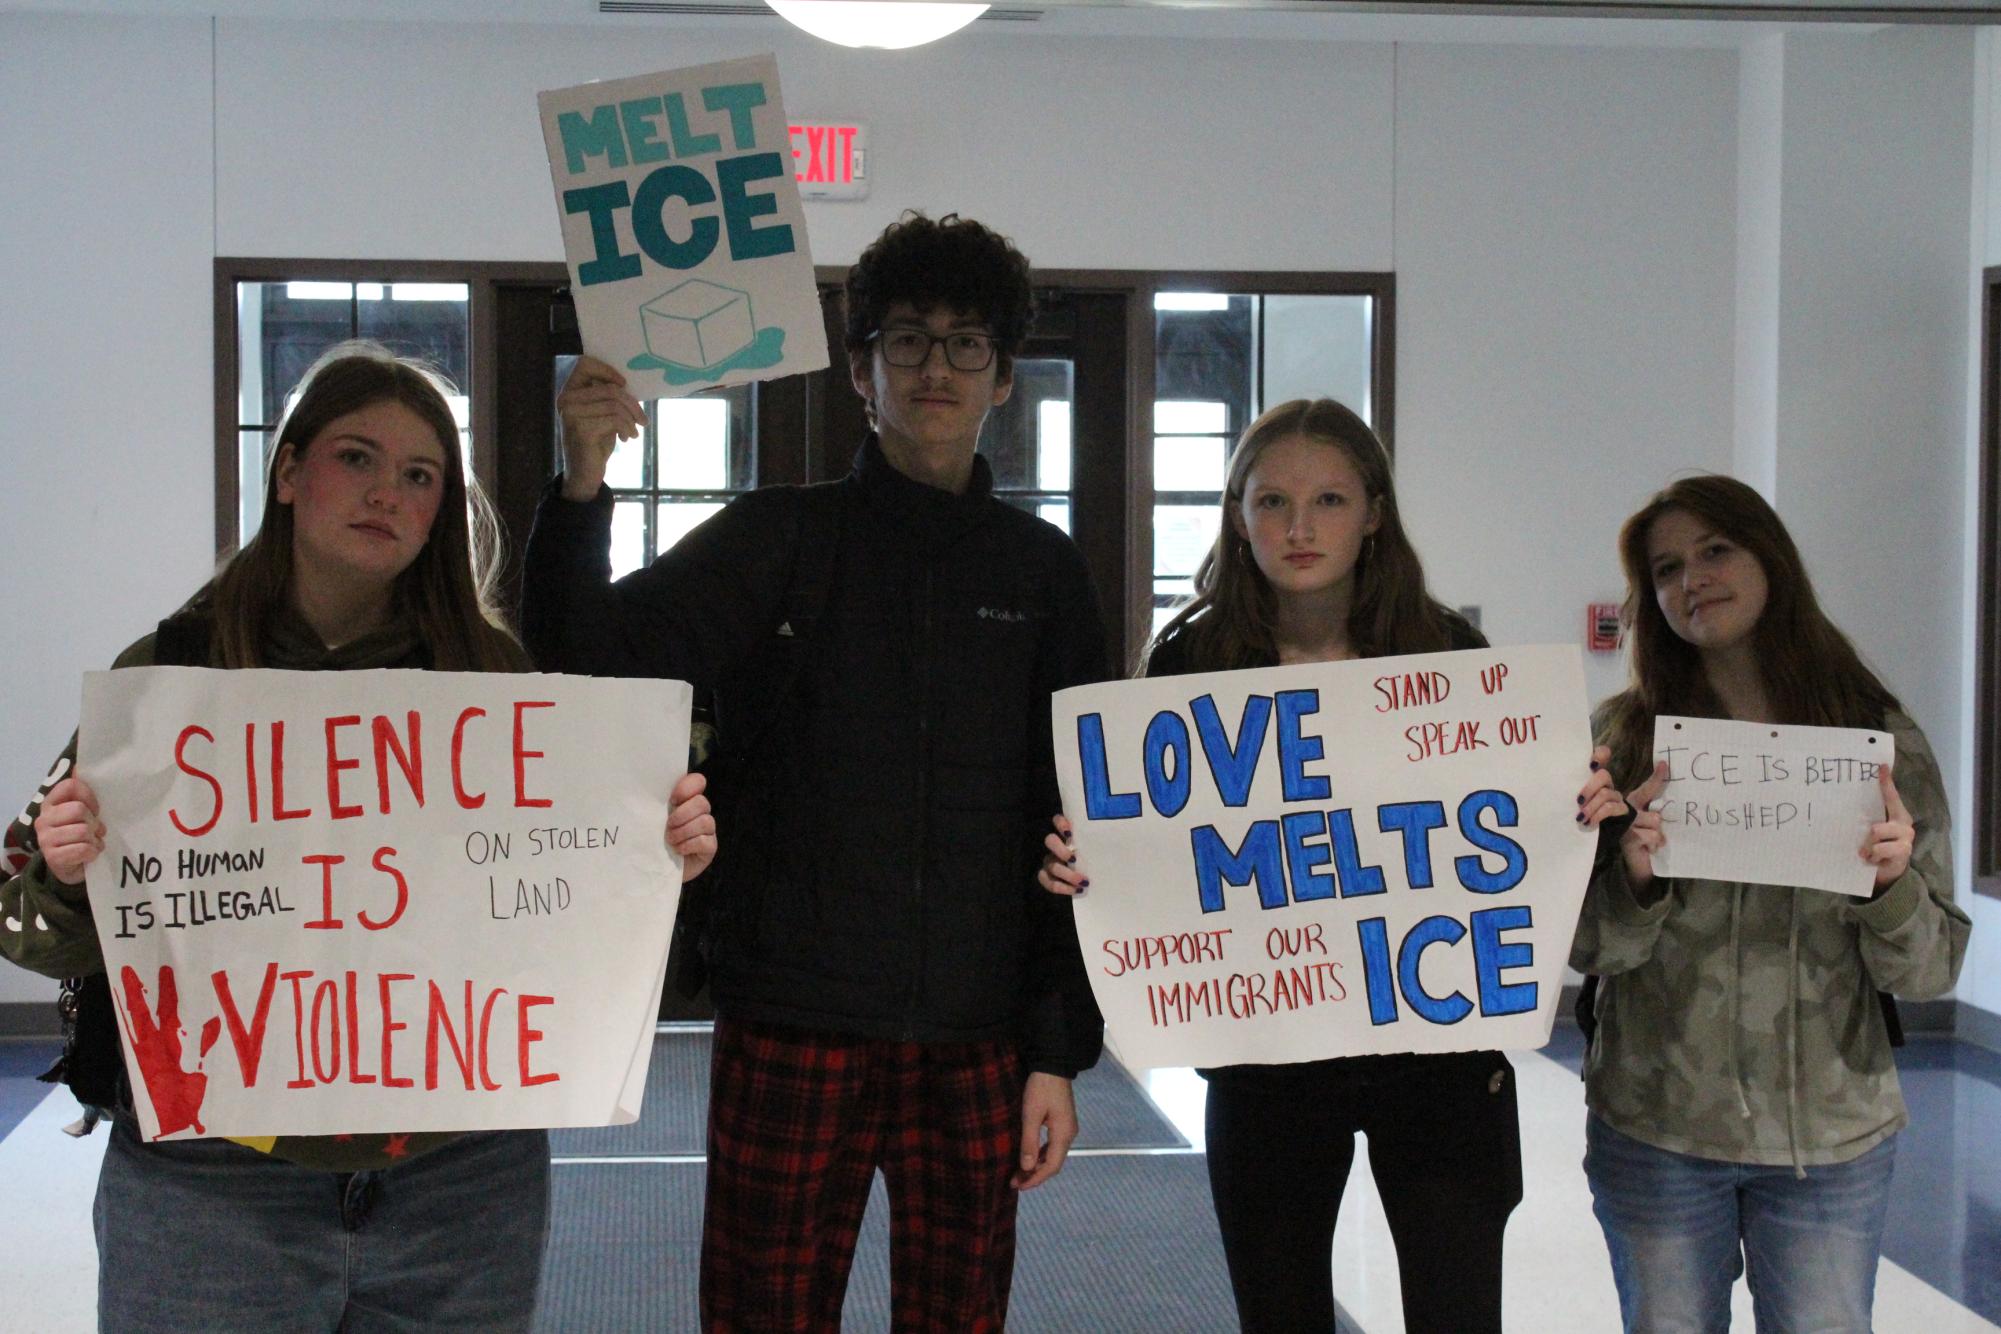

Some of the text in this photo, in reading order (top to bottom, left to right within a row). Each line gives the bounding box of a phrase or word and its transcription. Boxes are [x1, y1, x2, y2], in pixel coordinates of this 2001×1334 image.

[557, 82, 767, 175] MELT
[563, 152, 796, 287] ICE
[1374, 663, 1509, 713] STAND UP
[1076, 688, 1332, 820] LOVE
[1404, 714, 1542, 762] SPEAK OUT
[1658, 746, 1881, 786] ICE IS BETTER
[168, 701, 556, 837] SILENCE
[1659, 800, 1813, 830] CRUSHED!
[120, 854, 163, 888] NO
[466, 825, 620, 865] ON STOLEN
[1190, 789, 1529, 914] MELTS
[115, 885, 295, 938] IS ILLEGAL
[302, 846, 409, 930] IS
[489, 876, 572, 920] LAND
[1103, 923, 1328, 977] SUPPORT OUR
[1356, 905, 1539, 1026] ICE
[1146, 962, 1348, 1027] IMMIGRANTS
[211, 962, 561, 1091] VIOLENCE
